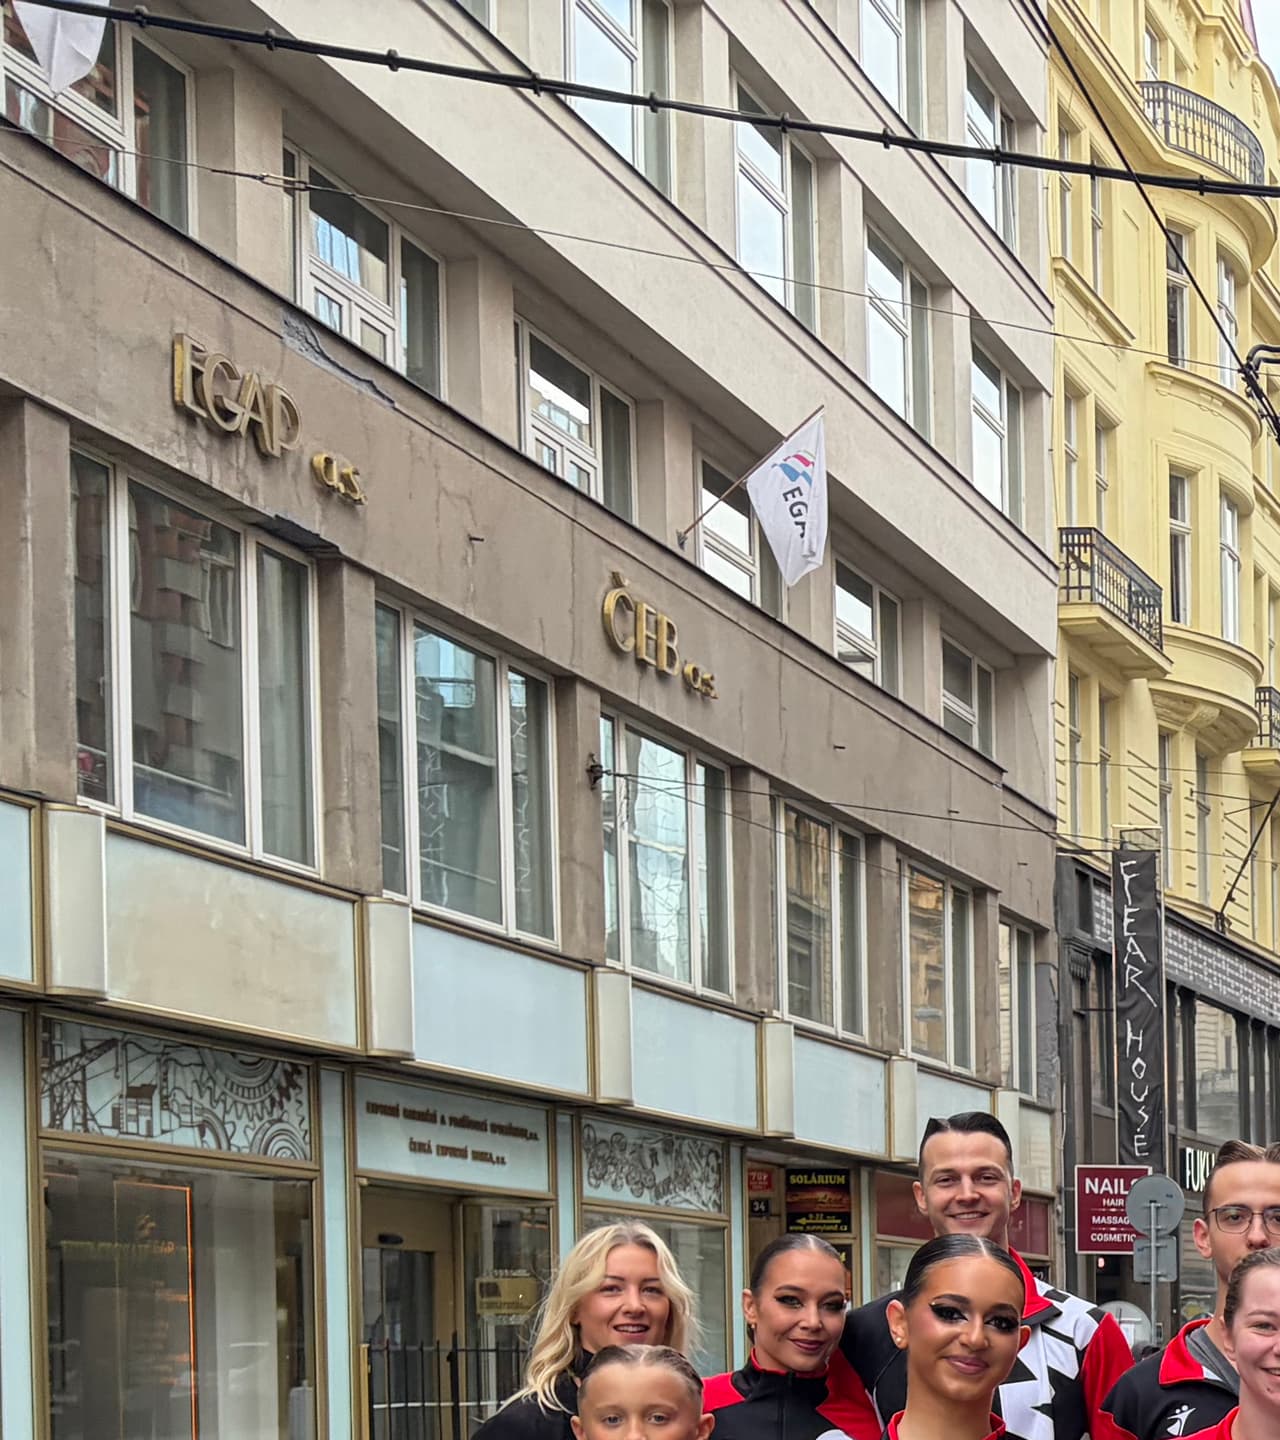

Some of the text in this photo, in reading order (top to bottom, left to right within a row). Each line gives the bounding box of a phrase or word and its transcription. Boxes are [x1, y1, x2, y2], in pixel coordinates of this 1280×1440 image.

[173, 333, 300, 458] EGAP
[602, 571, 680, 676] ČEB
[1120, 861, 1157, 1008] FEAR
[1127, 1019, 1149, 1157] HOUSE
[789, 1172, 847, 1185] SOLÁRIUM
[1085, 1177, 1138, 1195] NAIL
[753, 1201, 766, 1212] 34
[1103, 1198, 1125, 1207] HAIR
[1092, 1216, 1130, 1225] MASSAG
